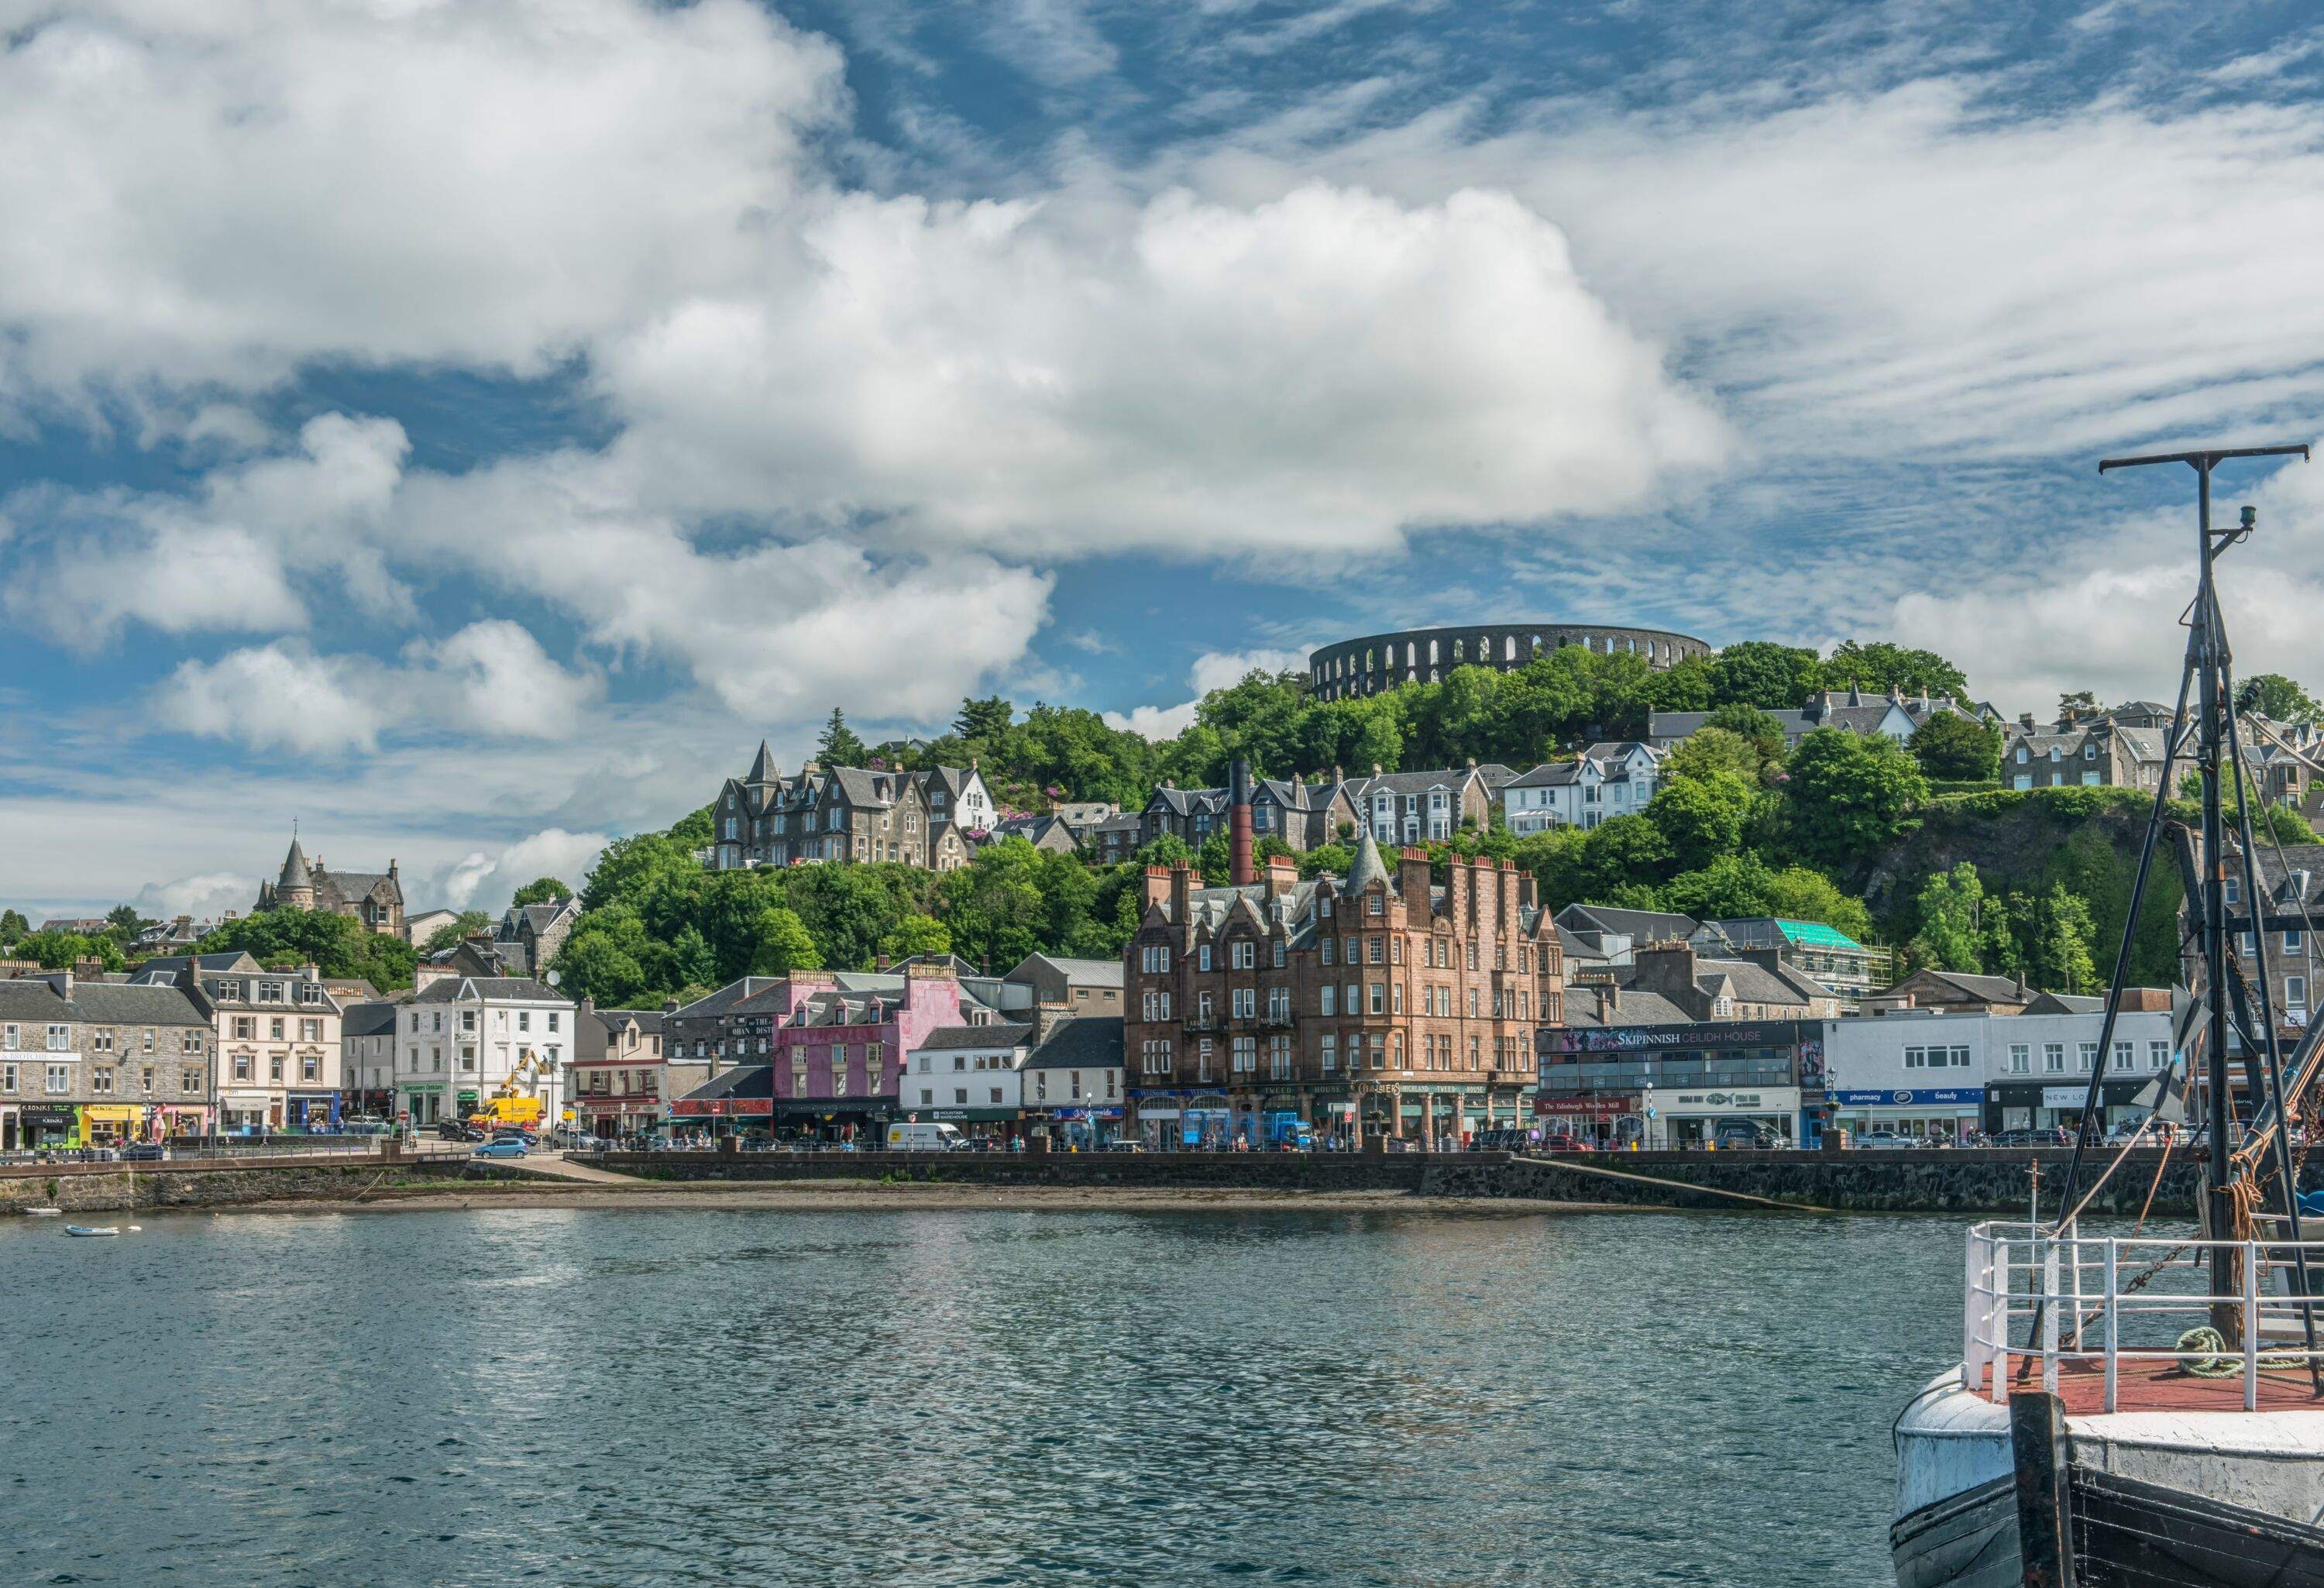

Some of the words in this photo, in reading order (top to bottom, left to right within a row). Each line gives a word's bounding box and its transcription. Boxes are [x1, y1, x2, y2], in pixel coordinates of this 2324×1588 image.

[1618, 1033, 1680, 1046] SKIPINNISH
[1682, 1033, 1721, 1043] CEILIDH
[1724, 1031, 1761, 1041] HOUSE
[1403, 1084, 1428, 1093] HIGHLAND
[1850, 1093, 1881, 1102] pharmacy
[1935, 1091, 1958, 1101] beauty
[1556, 1102, 1583, 1111] Edinburgh
